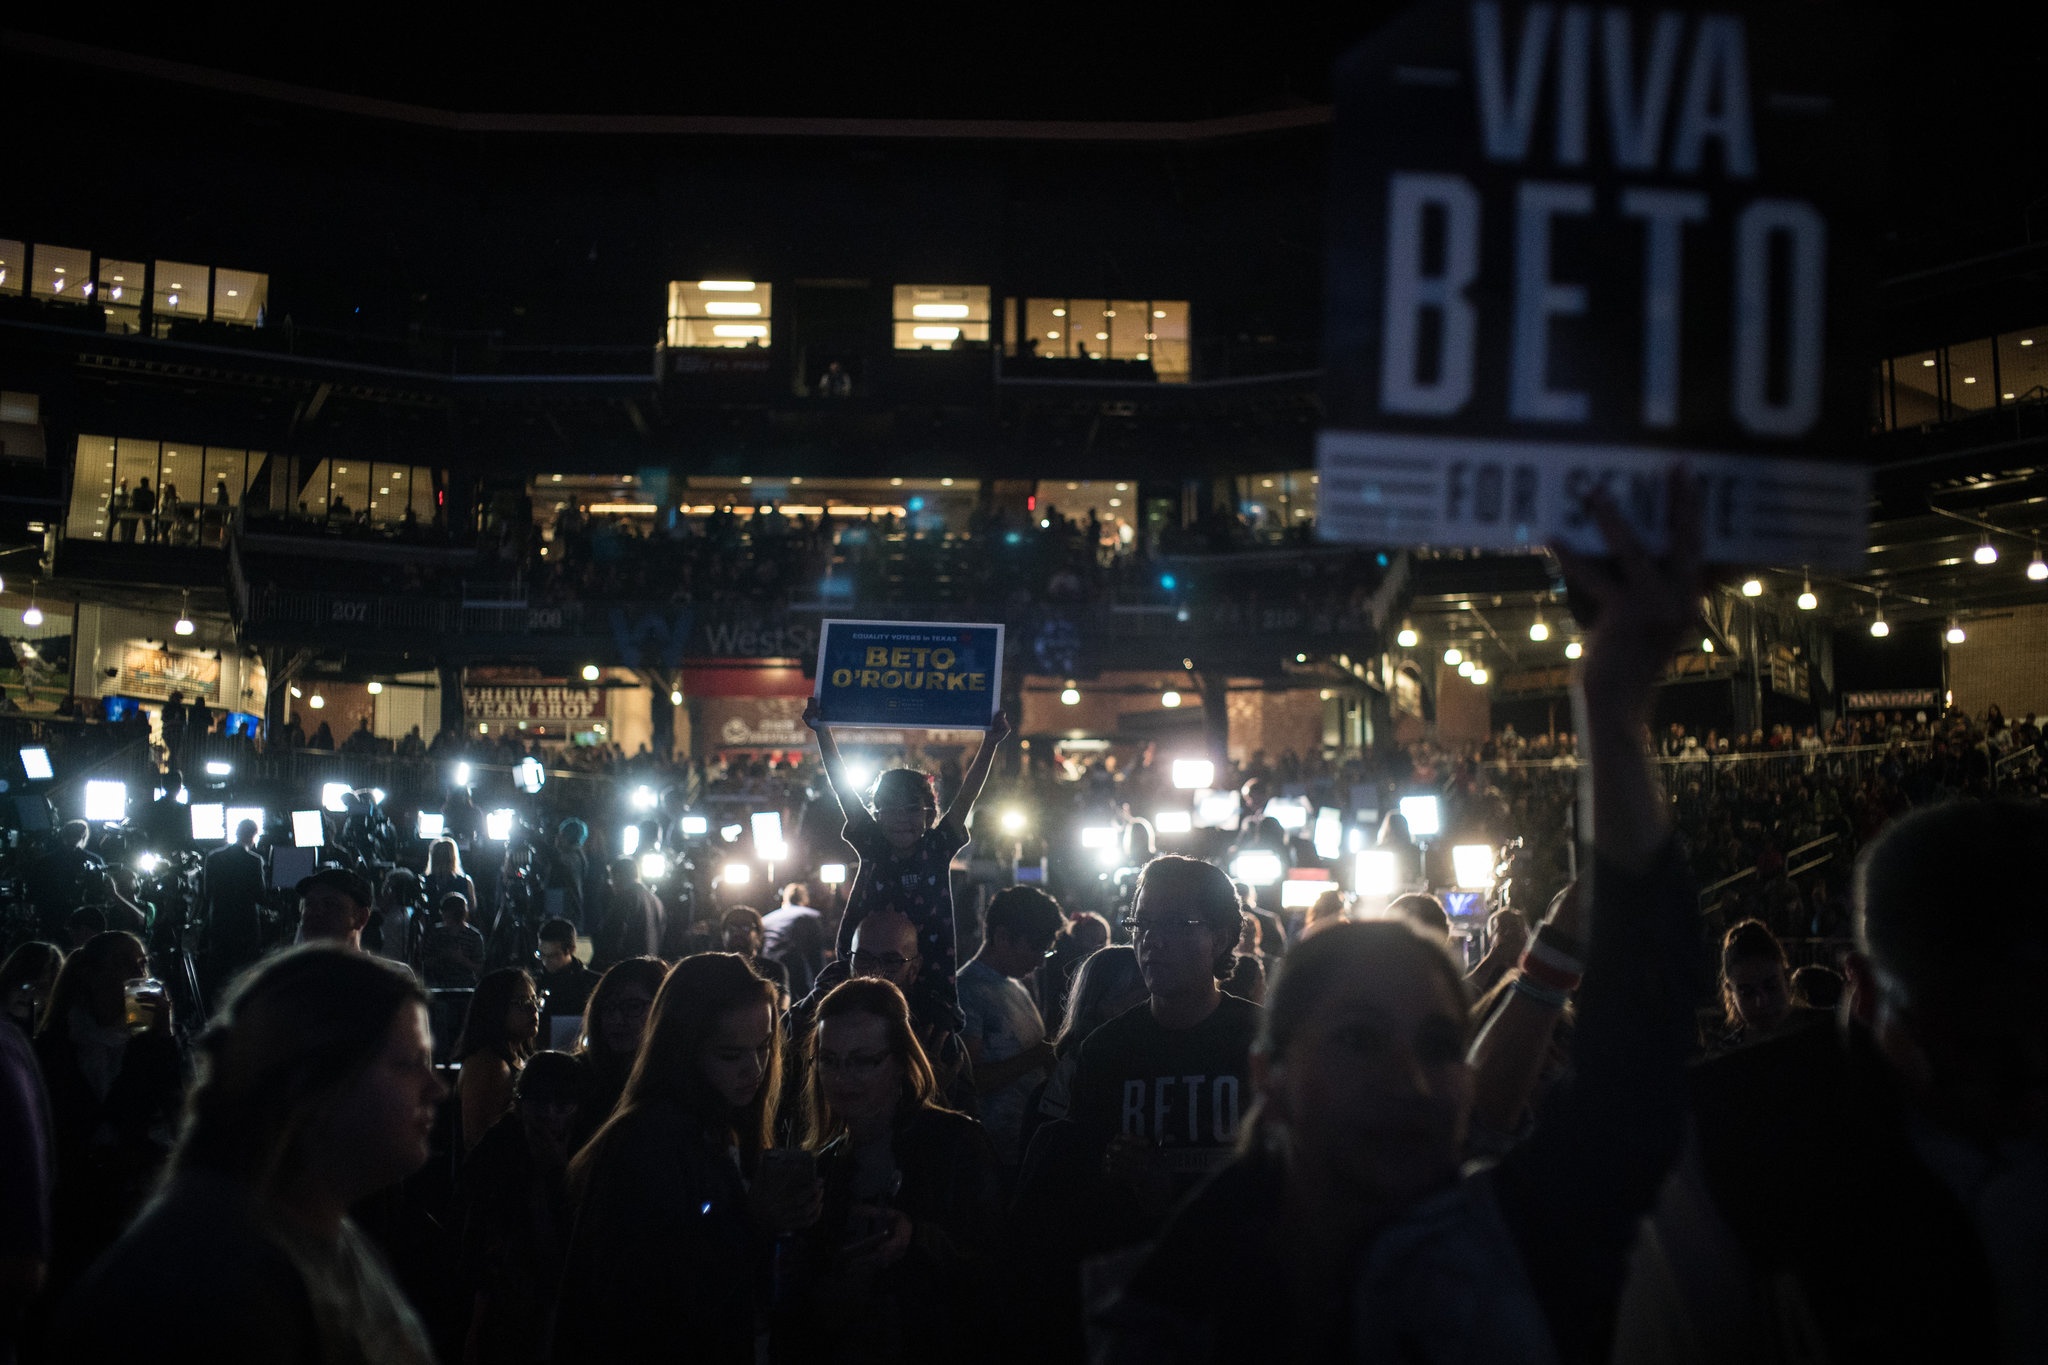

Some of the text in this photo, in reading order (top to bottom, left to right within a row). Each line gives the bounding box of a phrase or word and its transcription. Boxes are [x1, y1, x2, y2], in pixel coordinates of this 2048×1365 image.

[1468, 0, 1759, 180] VIVA
[1377, 170, 1830, 438] BETO
[1444, 458, 1538, 526] FOR
[331, 602, 368, 622] 207
[852, 632, 889, 641] EQUALITY
[890, 633, 921, 642] VOTERS
[931, 634, 957, 642] TEXAS
[865, 646, 956, 670] BETO
[832, 668, 986, 691] O'ROURKE
[468, 702, 595, 719] TEAM SHOP
